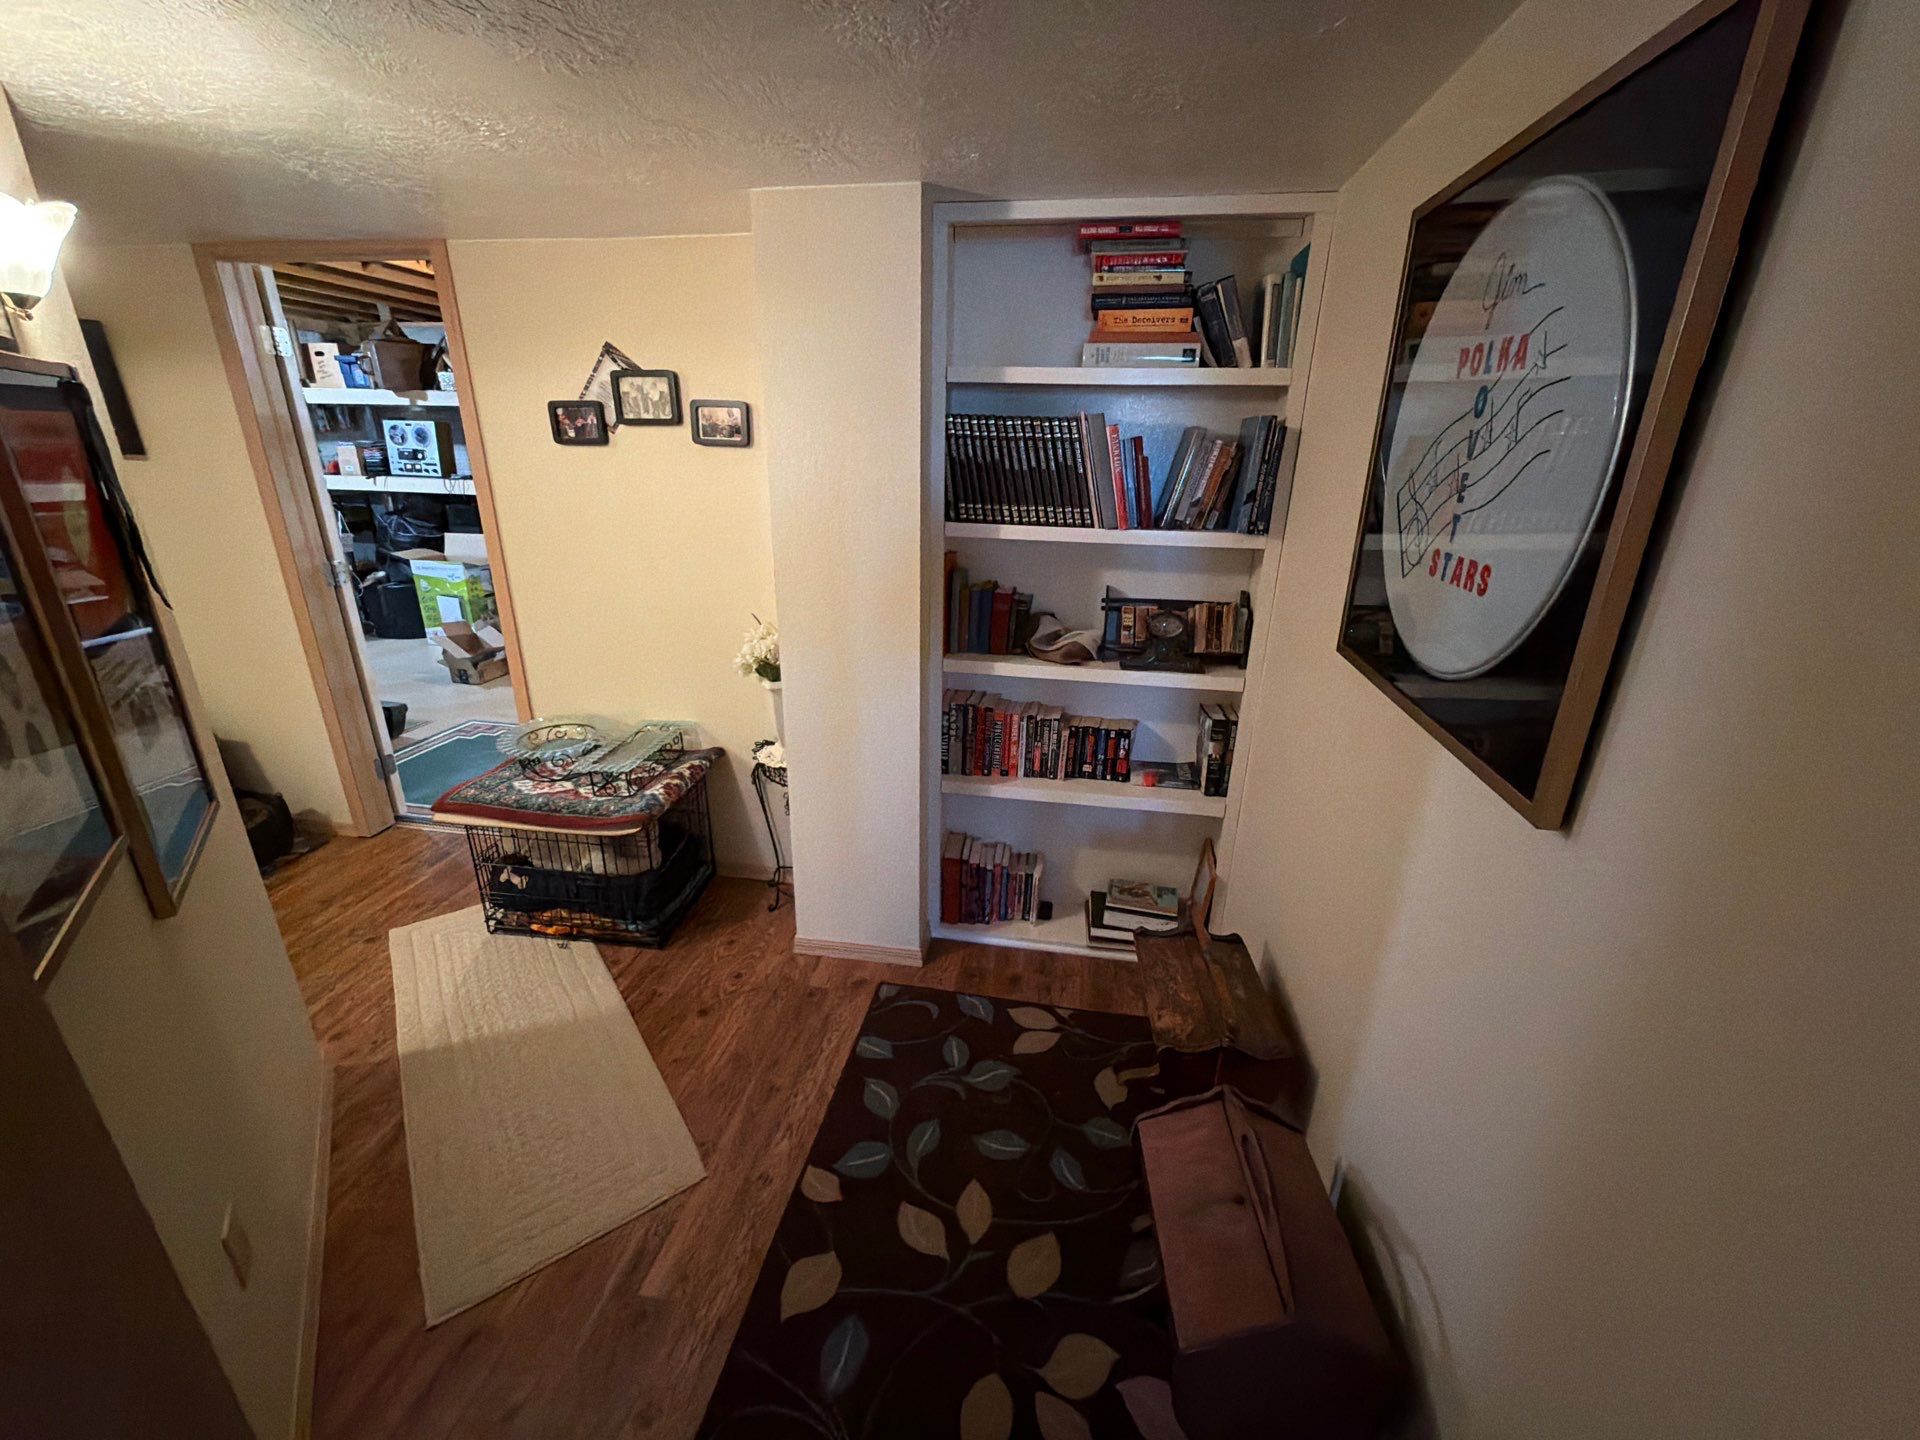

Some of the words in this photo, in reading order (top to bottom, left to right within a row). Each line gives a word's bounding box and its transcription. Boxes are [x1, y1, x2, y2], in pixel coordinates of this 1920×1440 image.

[1482, 251, 1546, 331] Jim
[1113, 316, 1128, 324] The
[1132, 316, 1176, 324] Deceivers
[1456, 332, 1532, 380] POLKA
[1428, 547, 1493, 598] STARS
